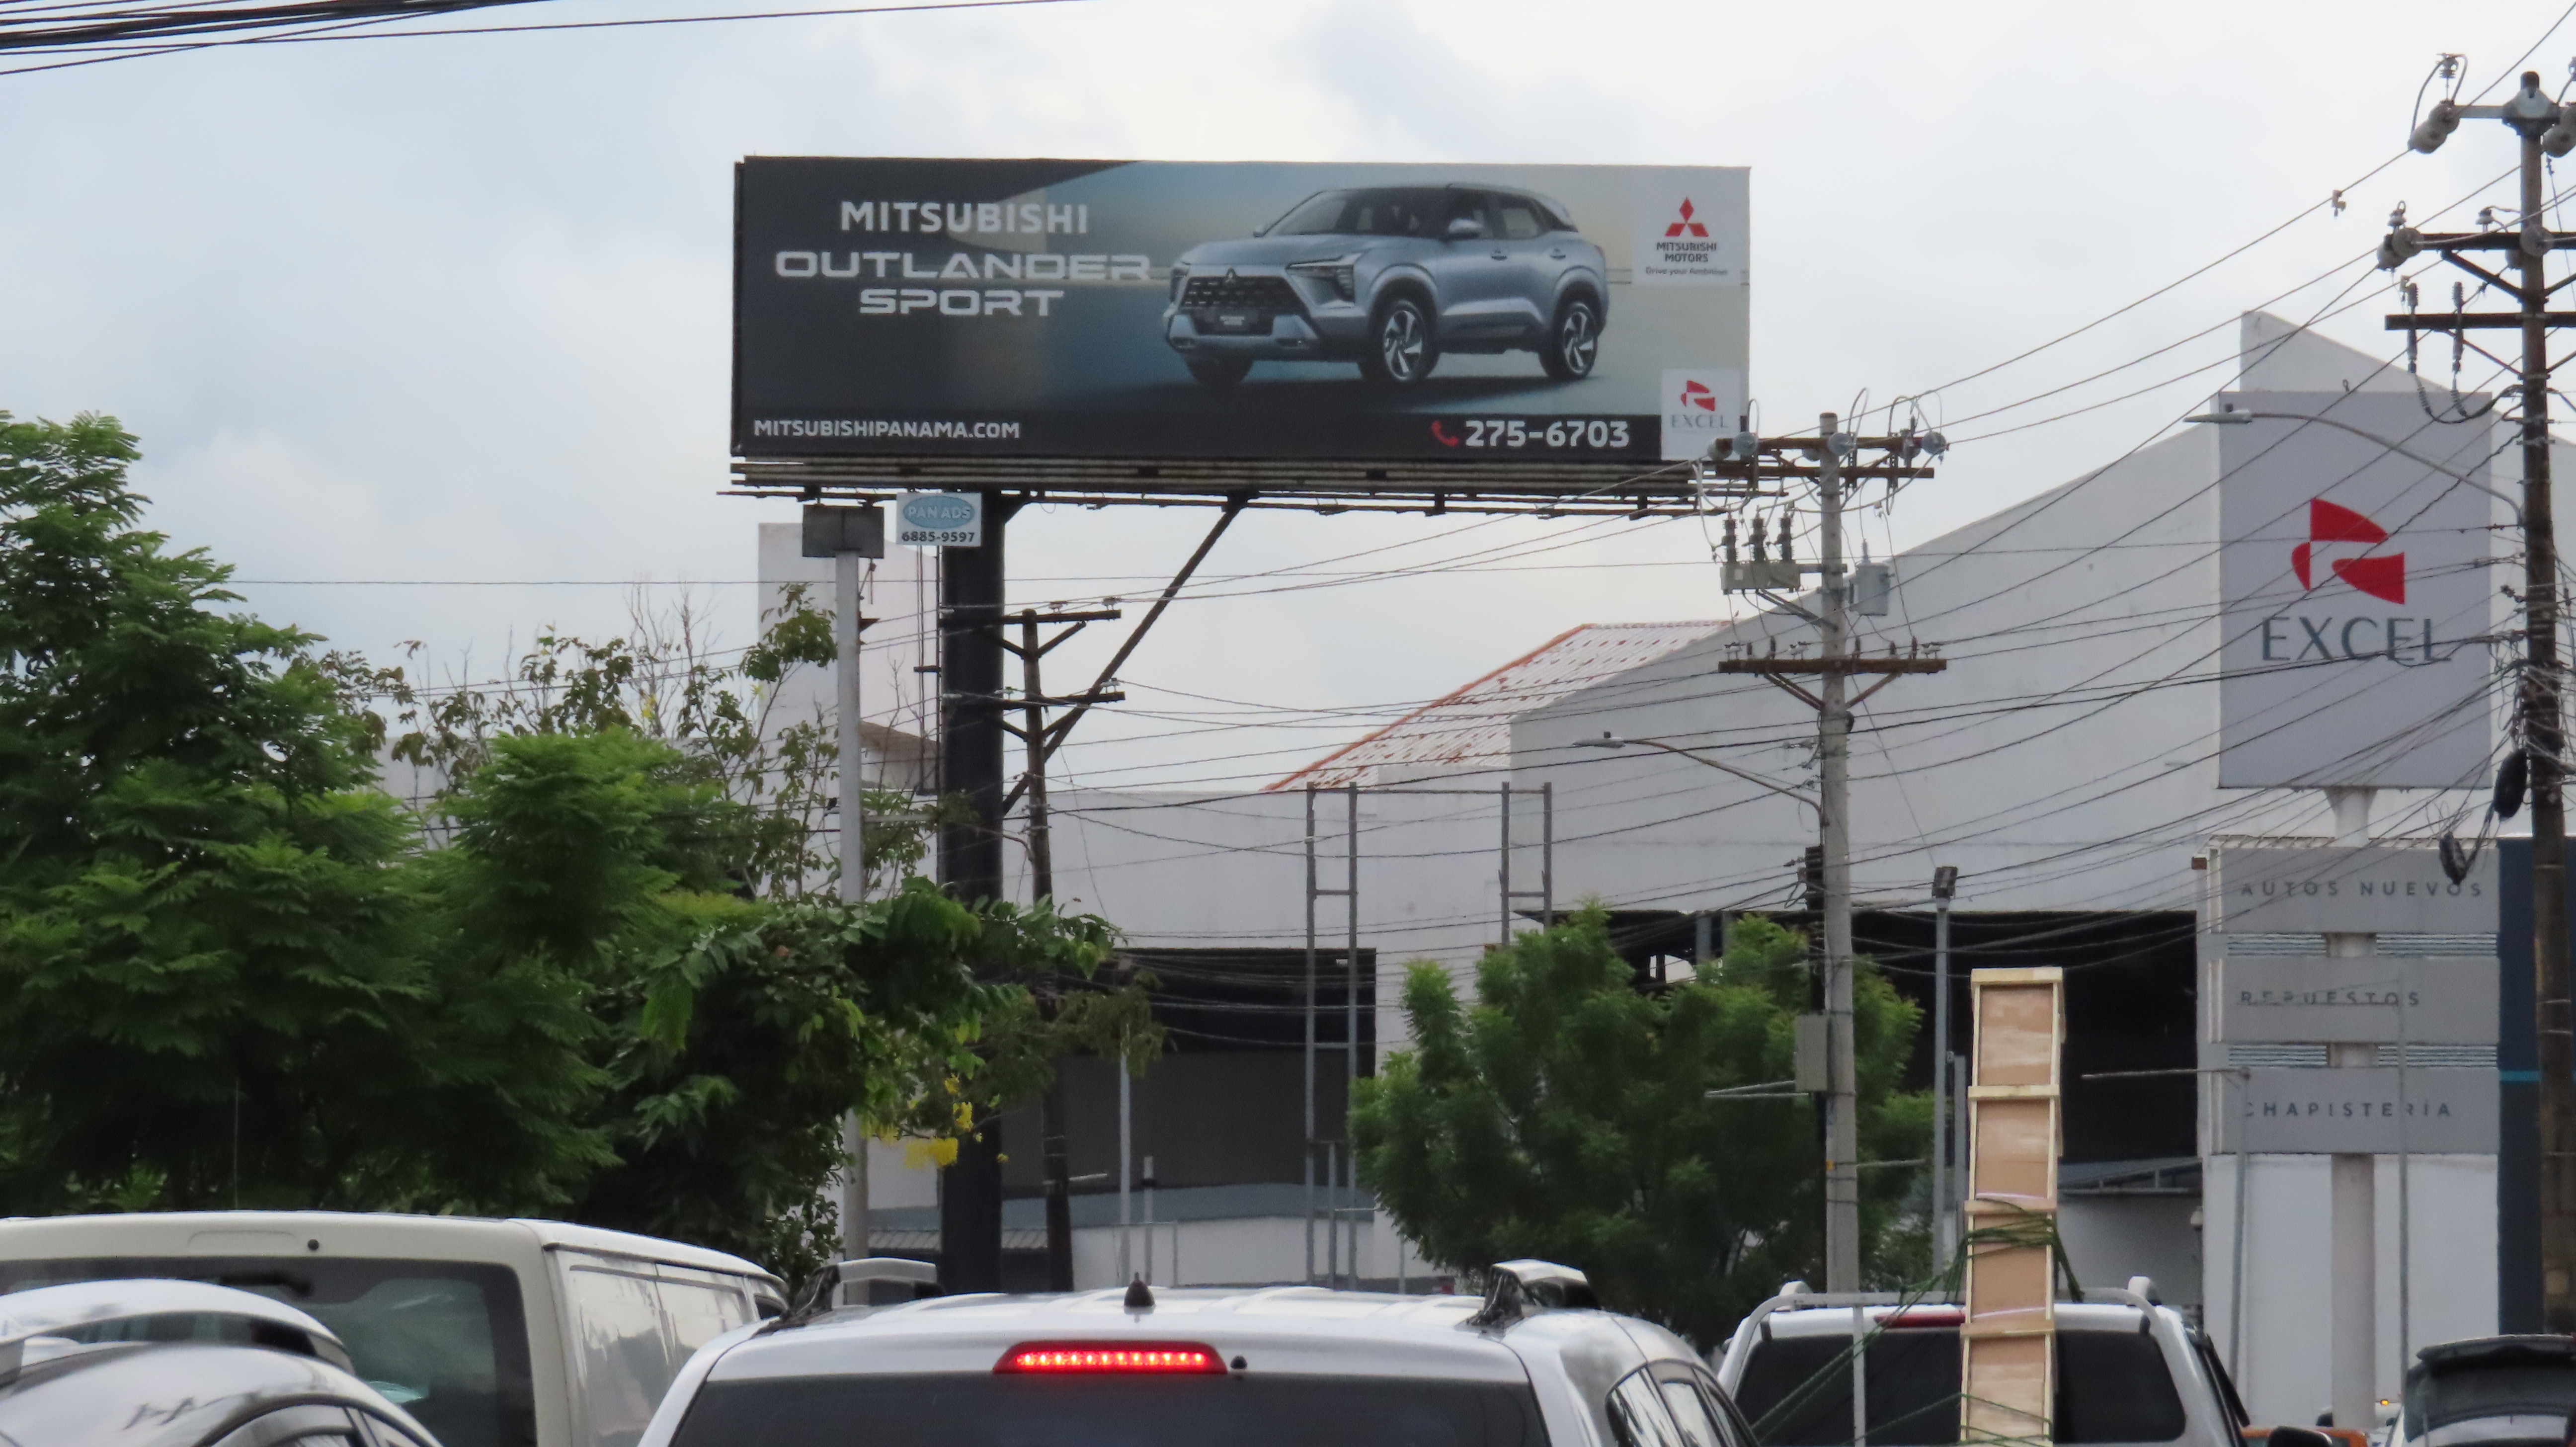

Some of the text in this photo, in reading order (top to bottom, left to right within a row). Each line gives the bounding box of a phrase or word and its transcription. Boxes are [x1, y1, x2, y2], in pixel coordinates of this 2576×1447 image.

[841, 201, 1087, 234] MITSUBISHI
[1656, 242, 1717, 251] MITSUBISHI
[775, 250, 1150, 280] OUTLANDER
[1665, 253, 1709, 262] MOTORS
[860, 288, 1064, 317] SPORT
[754, 419, 1020, 439] MITSUBISHIPANAMA.COM
[1671, 414, 1728, 428] EXCEL
[1465, 420, 1630, 447] 275-6703
[908, 506, 971, 519] PAN ADS
[901, 531, 974, 543] 6885-9597
[2261, 617, 2452, 662] EXCEL
[2241, 881, 2482, 896] AUTOS NUEVOS
[2241, 990, 2419, 1006] REPUESTOS
